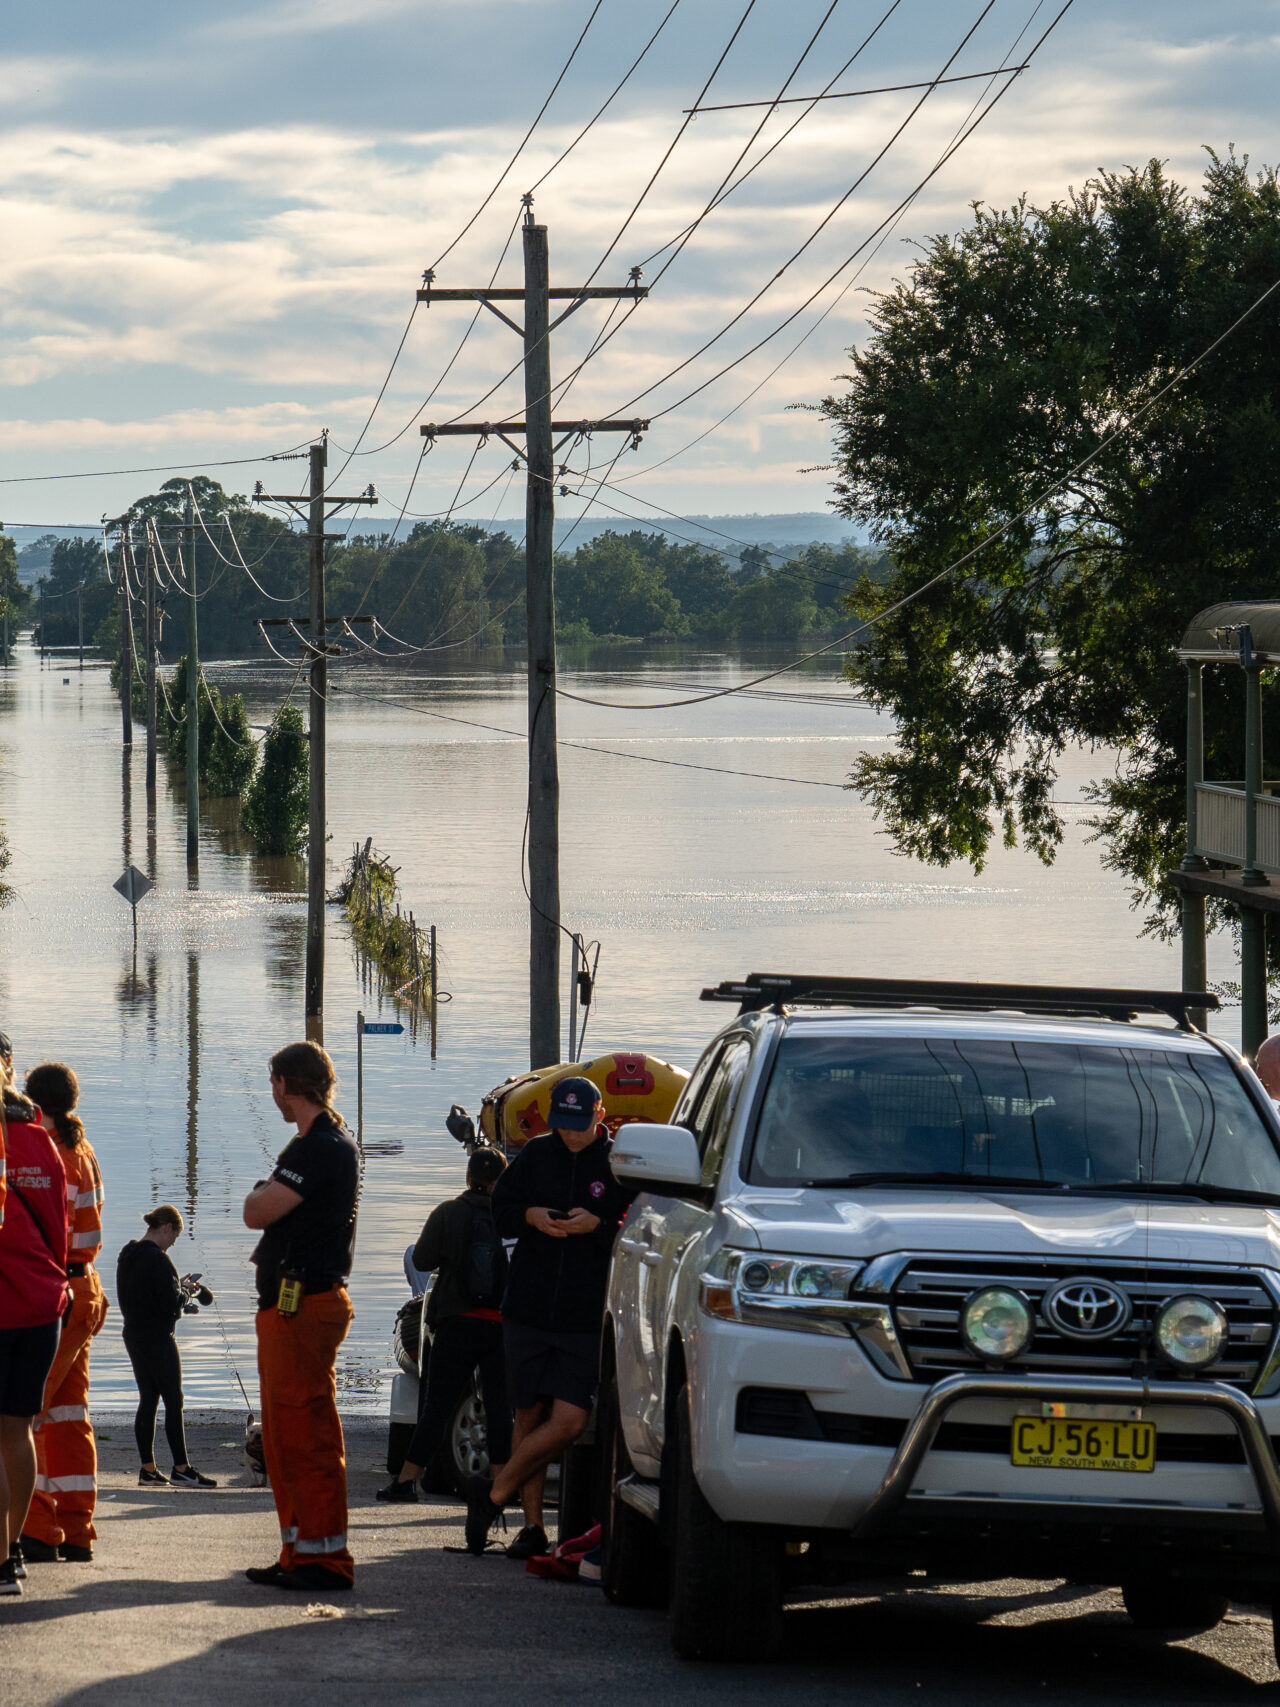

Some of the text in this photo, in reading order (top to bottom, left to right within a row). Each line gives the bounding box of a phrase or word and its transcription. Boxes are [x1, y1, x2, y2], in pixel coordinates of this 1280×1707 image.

[1029, 1456, 1137, 1470] NEW SOUTH WALES
